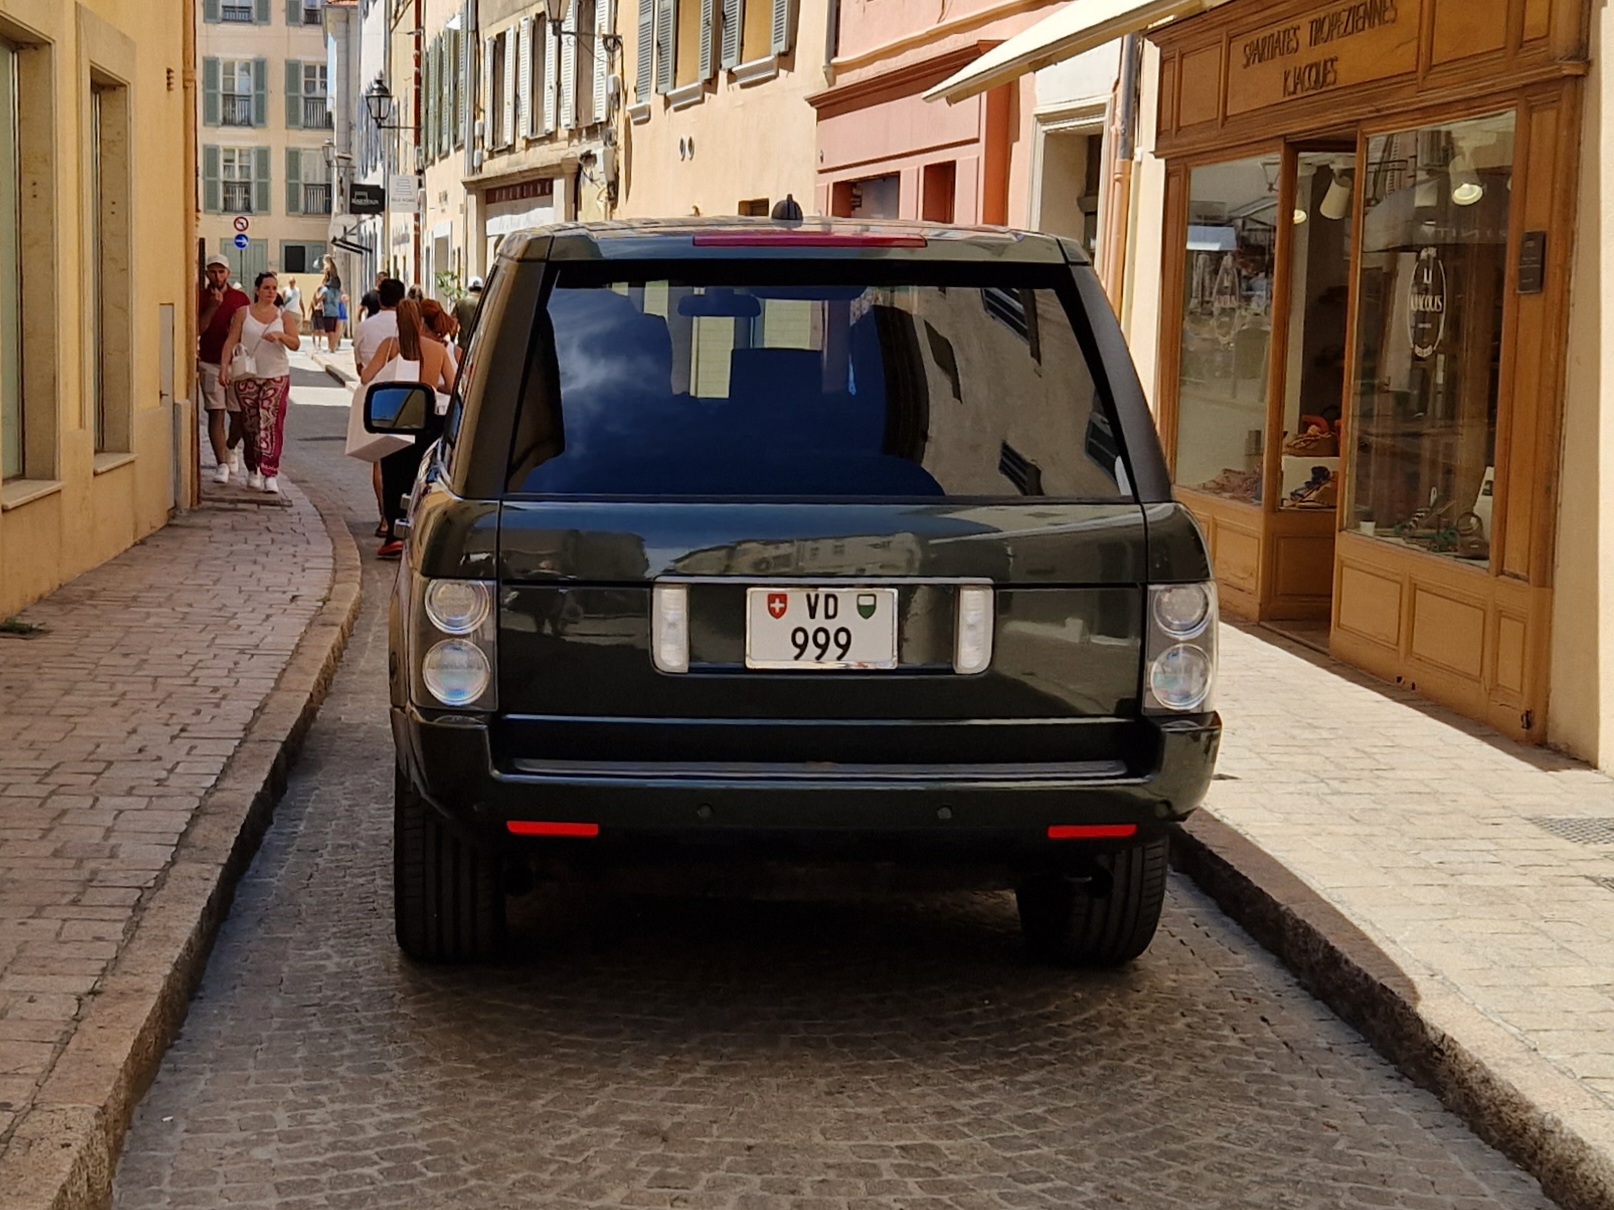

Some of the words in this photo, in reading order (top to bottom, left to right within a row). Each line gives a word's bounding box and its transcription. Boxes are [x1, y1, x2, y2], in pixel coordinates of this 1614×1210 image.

[1242, 25, 1300, 69] SPARTIATES
[806, 593, 838, 619] VD
[791, 626, 852, 661] 999
